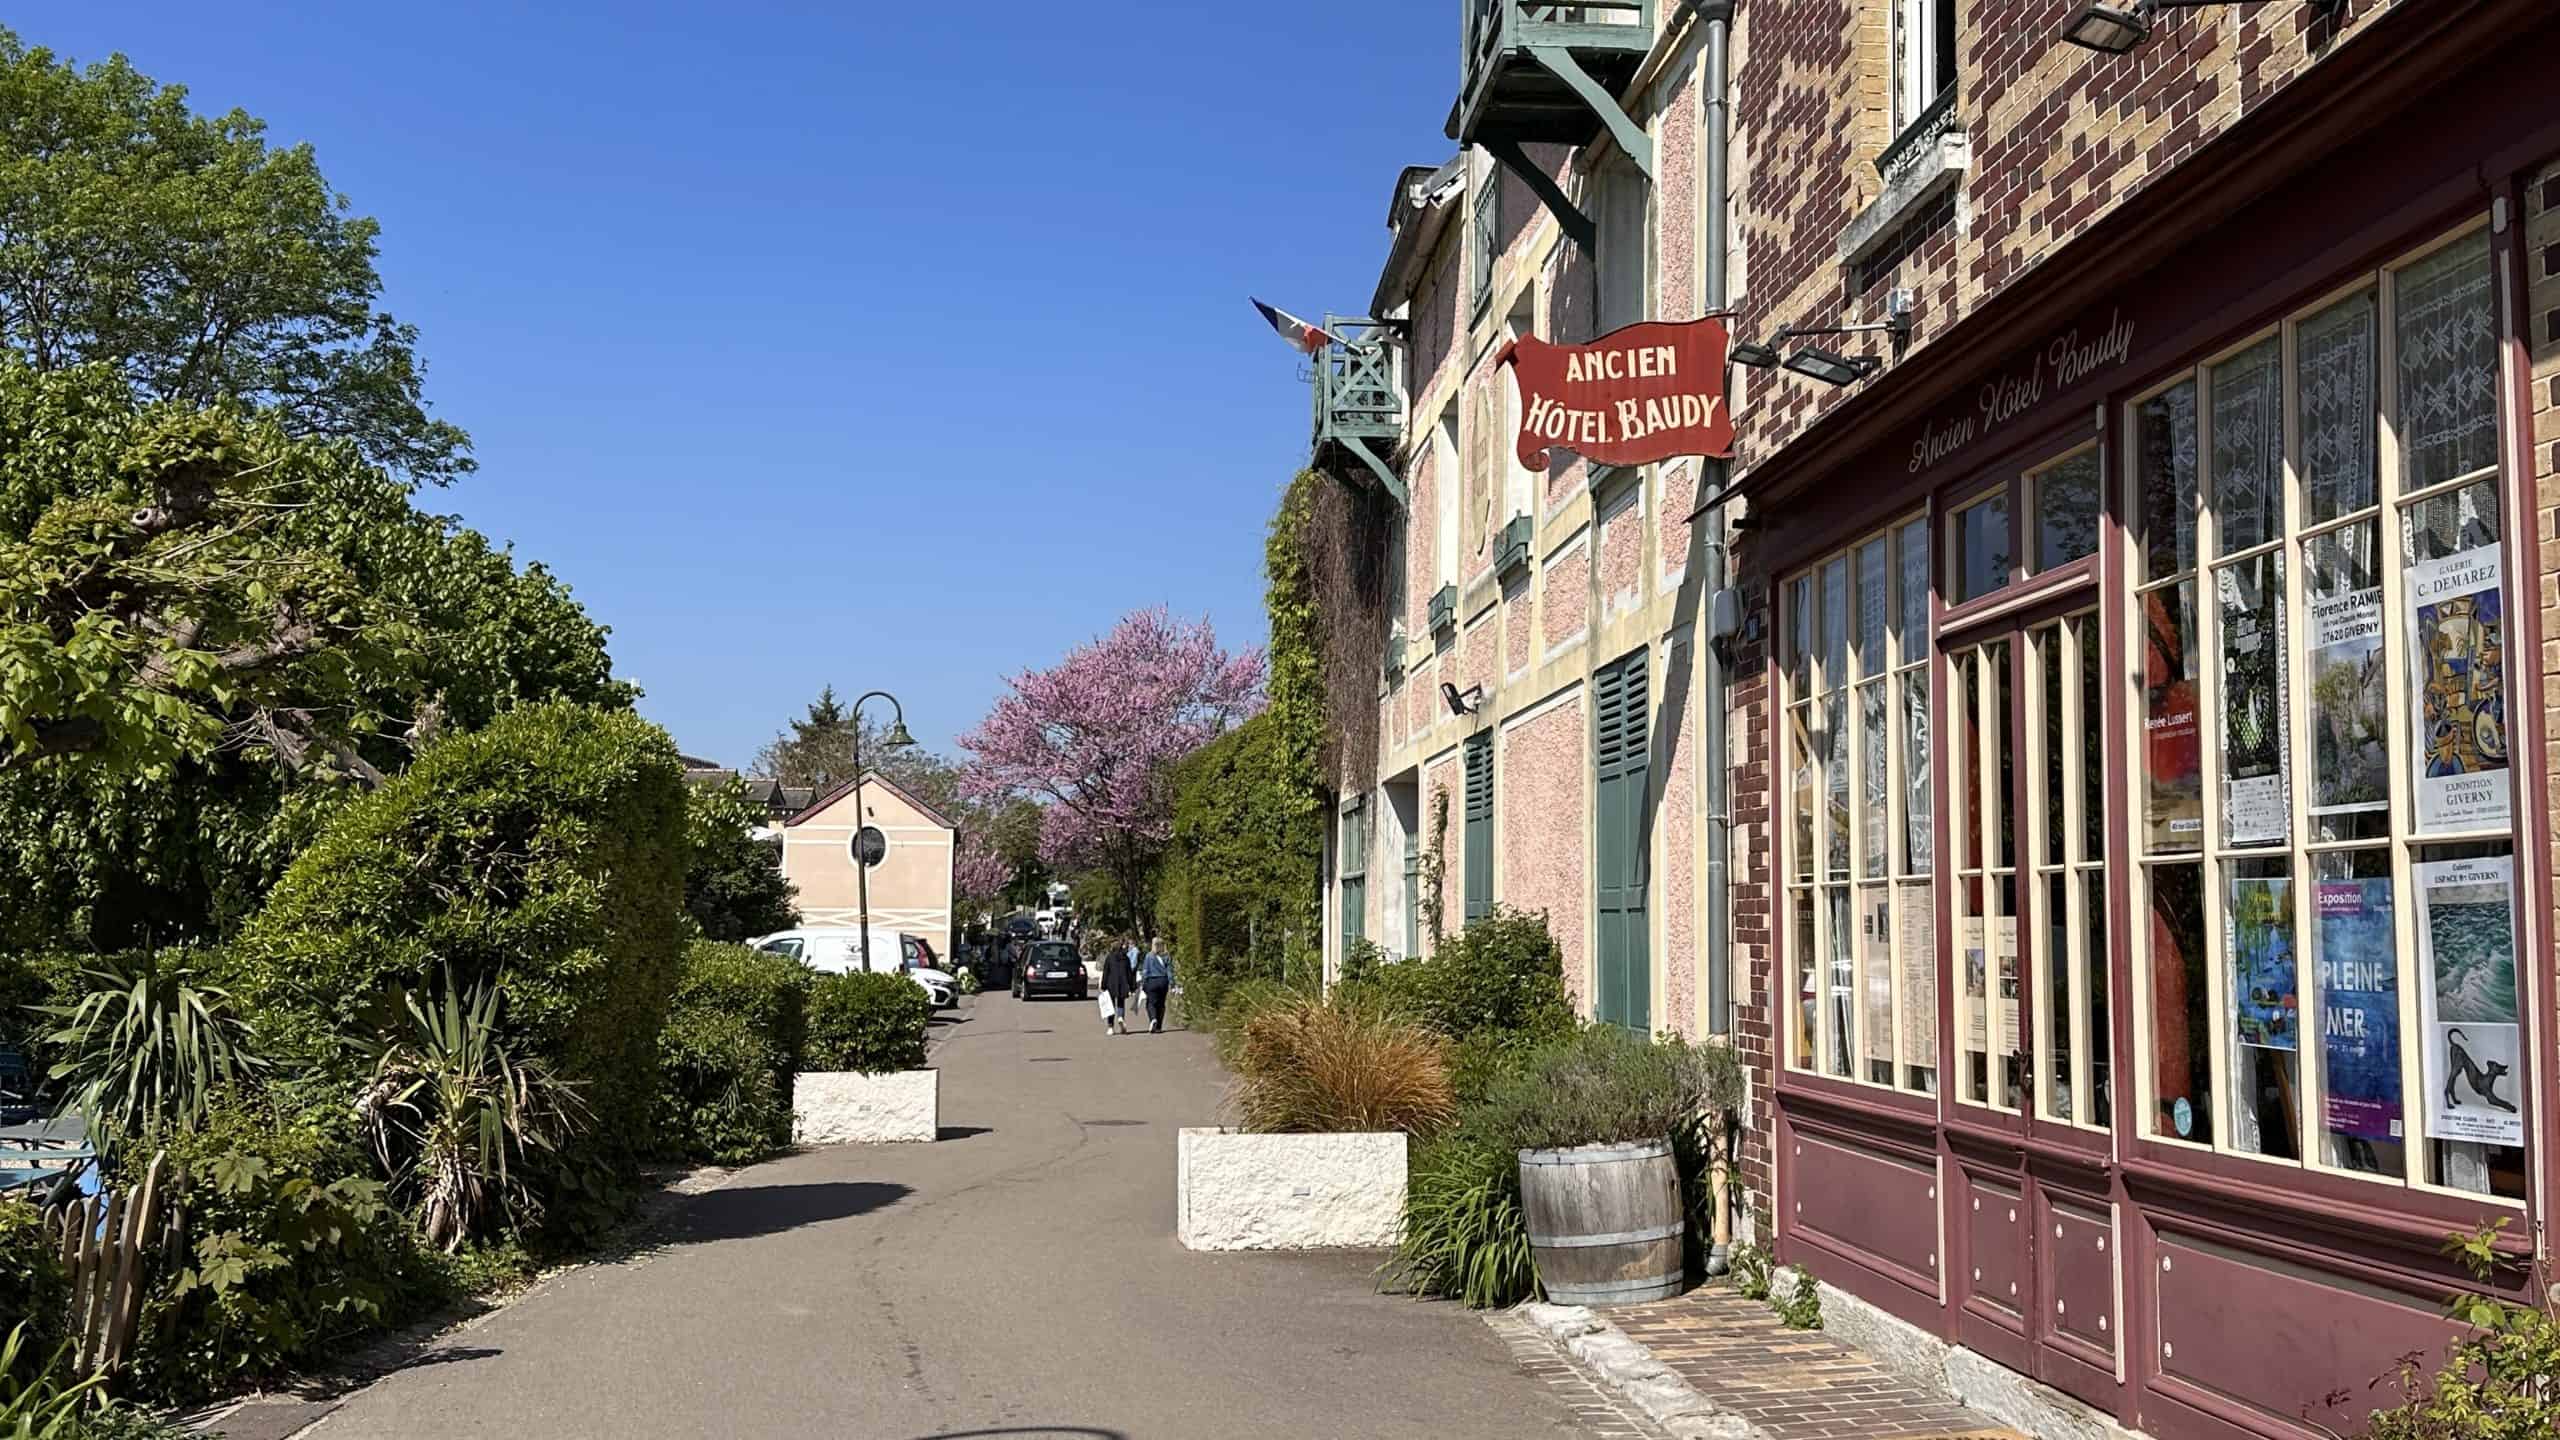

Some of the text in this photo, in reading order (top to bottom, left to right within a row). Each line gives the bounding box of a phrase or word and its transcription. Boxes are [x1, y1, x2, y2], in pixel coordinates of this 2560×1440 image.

[1566, 345, 1677, 383] ANCIEN
[1908, 308, 2135, 474] Ancien Hôtel Baudy
[1524, 393, 1723, 443] HÔTEL BAUDY
[2433, 565, 2496, 593] DEMAREZ
[2311, 600, 2349, 619] Florence
[2344, 621, 2379, 639] GIVERNY
[2445, 778, 2494, 792] EXPOSITION
[2446, 791, 2494, 806] GIVERNY
[2321, 960, 2384, 993] PLEINE
[2325, 1006, 2368, 1038] MER
